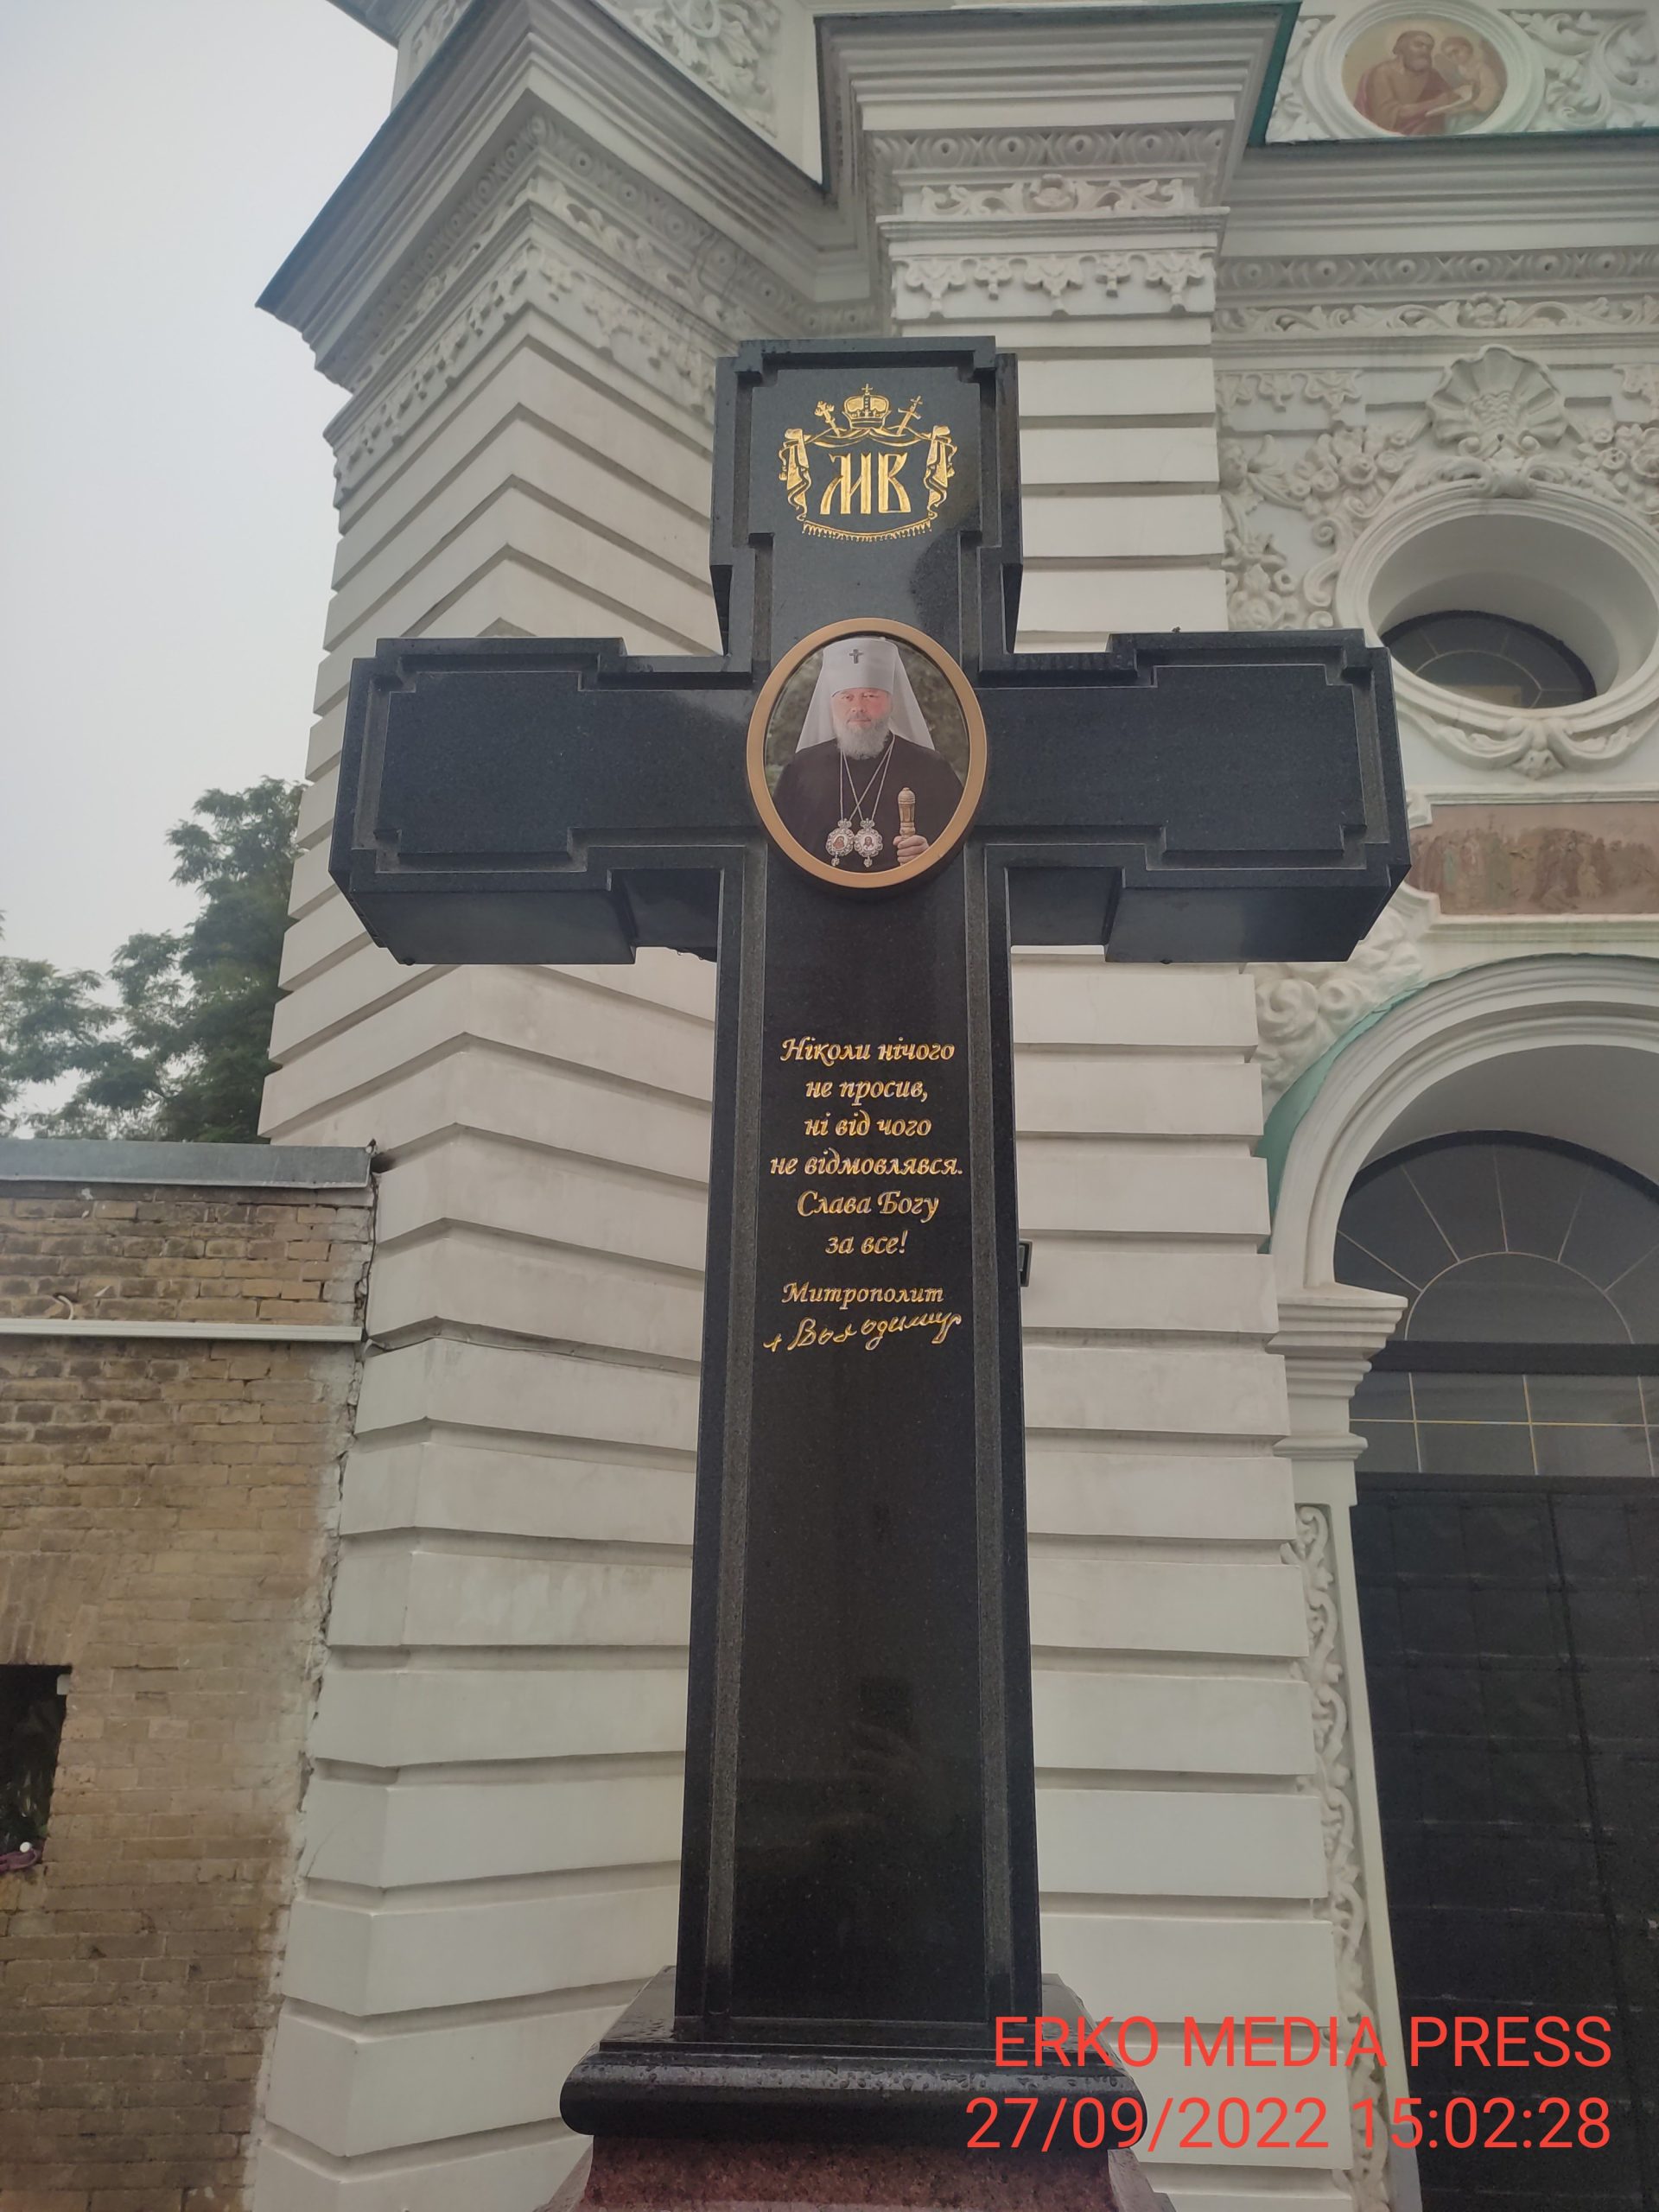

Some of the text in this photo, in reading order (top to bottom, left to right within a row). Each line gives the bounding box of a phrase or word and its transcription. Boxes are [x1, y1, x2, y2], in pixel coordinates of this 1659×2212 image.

[780, 1036, 956, 1067] Ніколи нічого
[805, 1080, 929, 1106] не просив,
[804, 1109, 932, 1137] ні від чого
[770, 1147, 963, 1176] не відмовлявся.
[797, 1190, 940, 1224] Слава Богу
[824, 1230, 908, 1255] за все!
[781, 1281, 944, 1311] Митрополит
